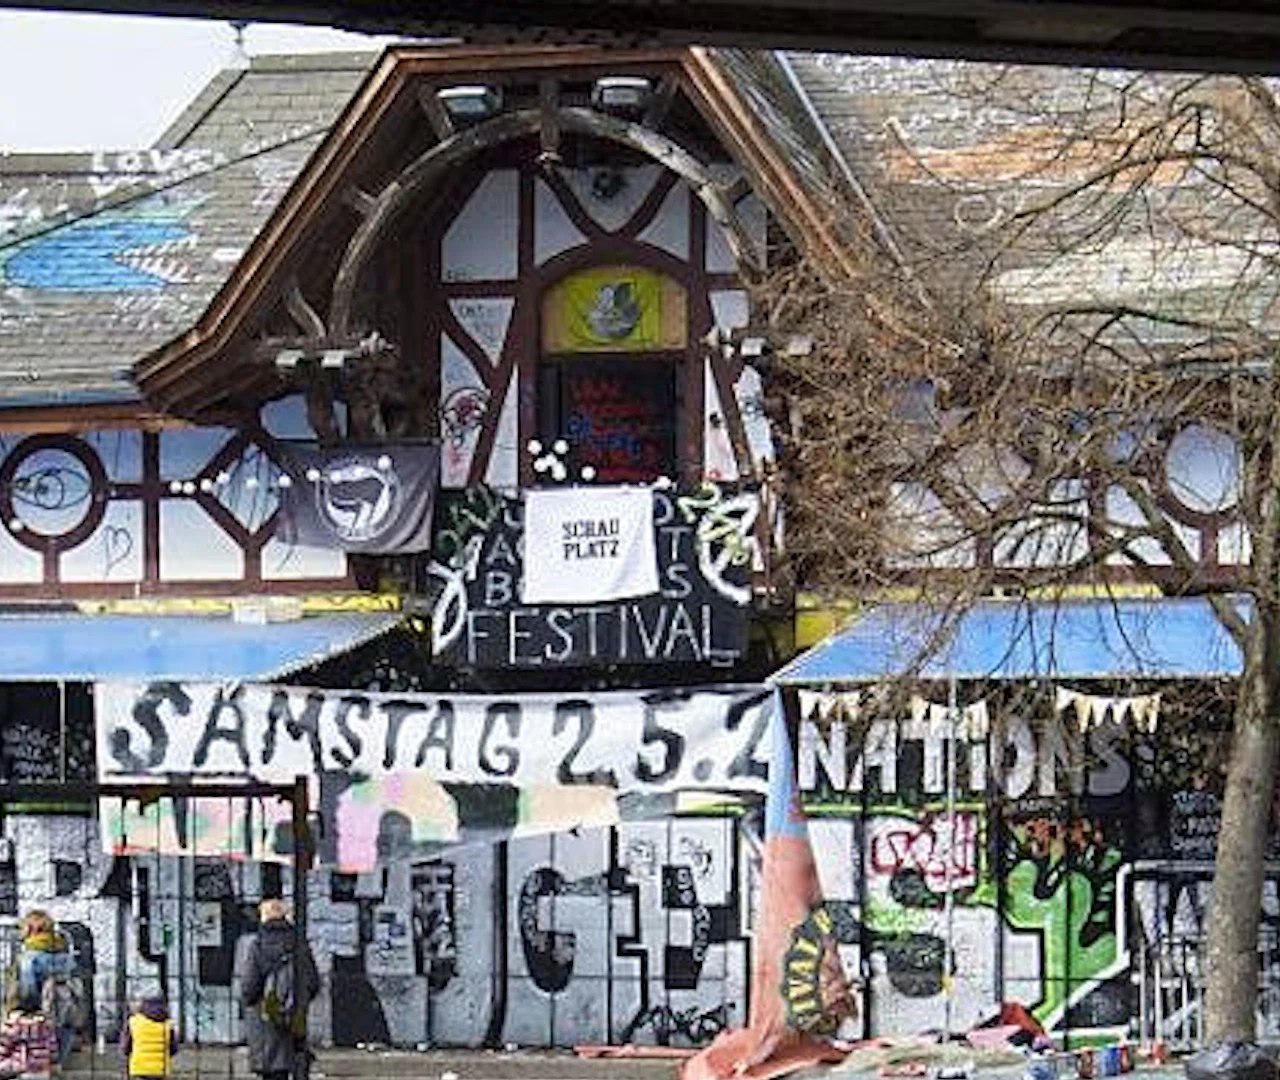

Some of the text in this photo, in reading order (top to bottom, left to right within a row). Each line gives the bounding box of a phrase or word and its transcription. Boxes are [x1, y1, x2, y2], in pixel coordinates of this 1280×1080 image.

[561, 518, 620, 540] SCHAU
[563, 540, 620, 560] PLATZ
[466, 603, 741, 667] FESTIVAL
[109, 683, 523, 779] SAMSTAG
[798, 718, 1132, 799] NATIONS
